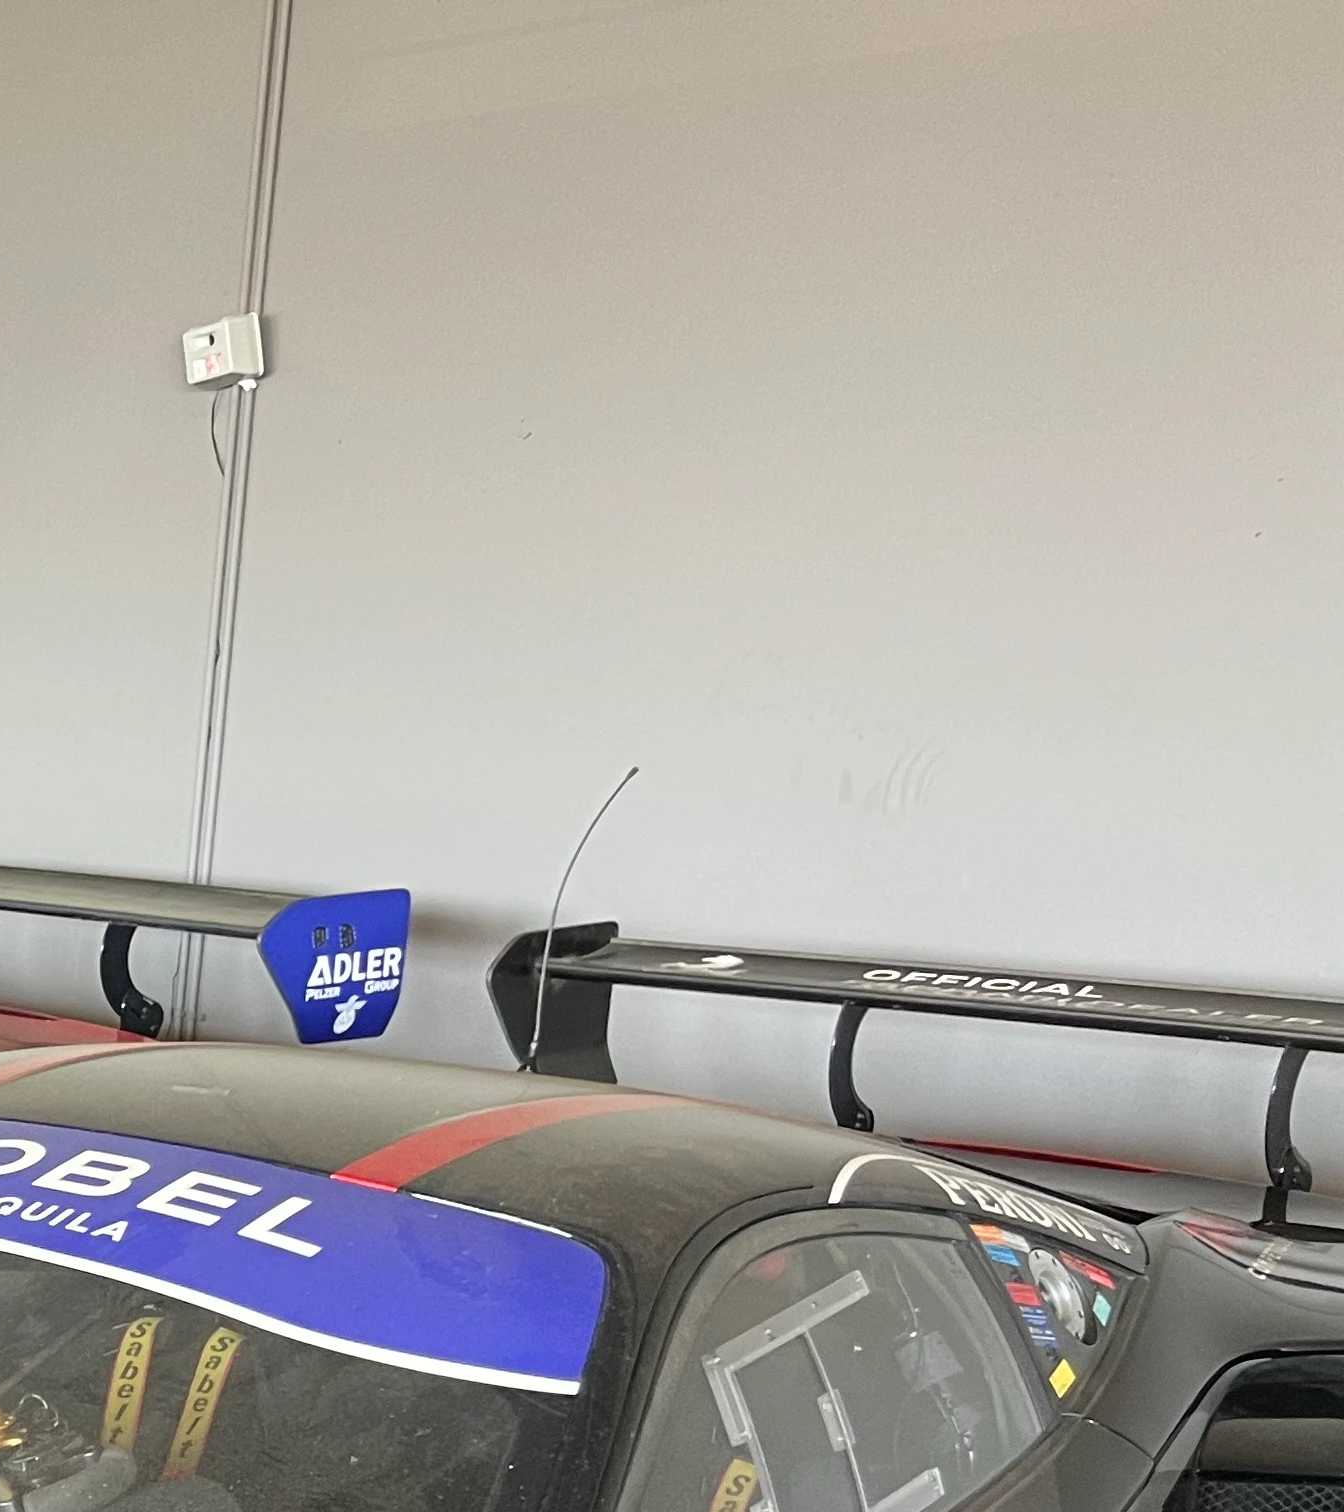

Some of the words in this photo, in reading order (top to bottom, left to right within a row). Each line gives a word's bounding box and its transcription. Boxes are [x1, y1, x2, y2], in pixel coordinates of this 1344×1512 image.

[306, 946, 402, 988] ADLER
[862, 968, 1104, 999] OFFICIAL
[912, 1164, 1098, 1243] PERONI
[108, 1321, 153, 1445] Sabelt
[178, 1335, 235, 1458] Sabelt
